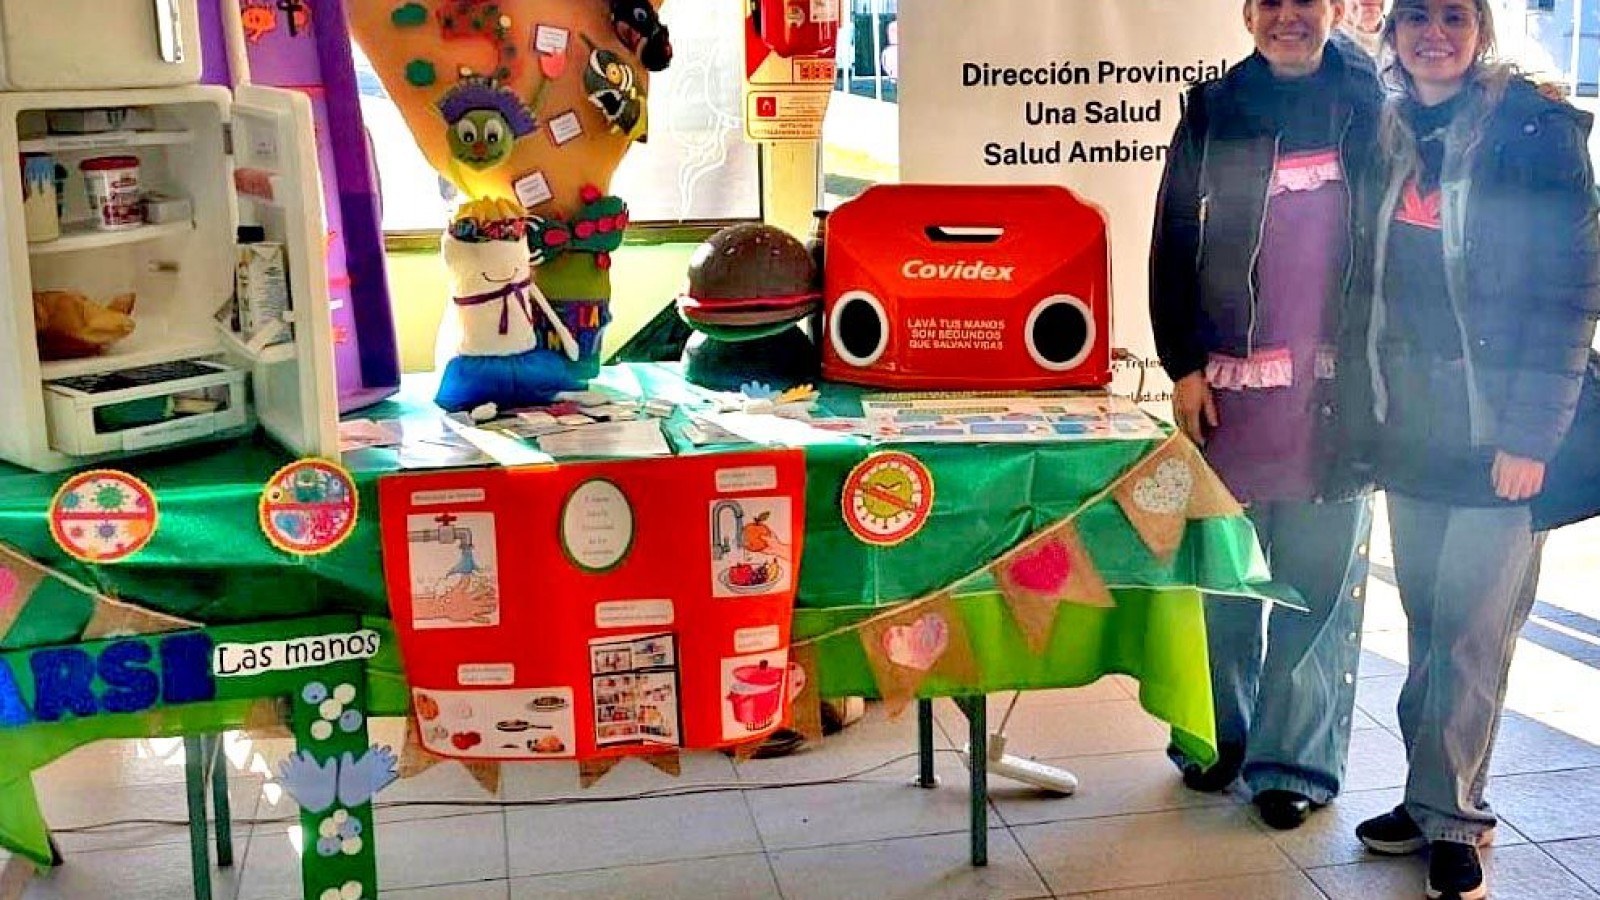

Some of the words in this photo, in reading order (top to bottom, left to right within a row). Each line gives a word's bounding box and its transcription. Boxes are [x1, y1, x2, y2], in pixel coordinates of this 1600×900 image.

[962, 61, 1090, 86] Dirección
[1099, 60, 1227, 85] Provincial
[1025, 101, 1077, 125] Una
[1085, 99, 1161, 123] Salud
[984, 141, 1061, 165] Salud
[902, 259, 1016, 281] Covidex
[911, 329, 935, 339] SON
[938, 329, 1002, 340] SEGUNDOS
[940, 318, 961, 329] TUS
[963, 319, 1005, 330] MANOS
[909, 340, 932, 349] QUE
[933, 340, 972, 349] SALVAN
[973, 341, 1003, 350] VIDAS
[217, 647, 272, 675] Las
[284, 633, 377, 667] manos
